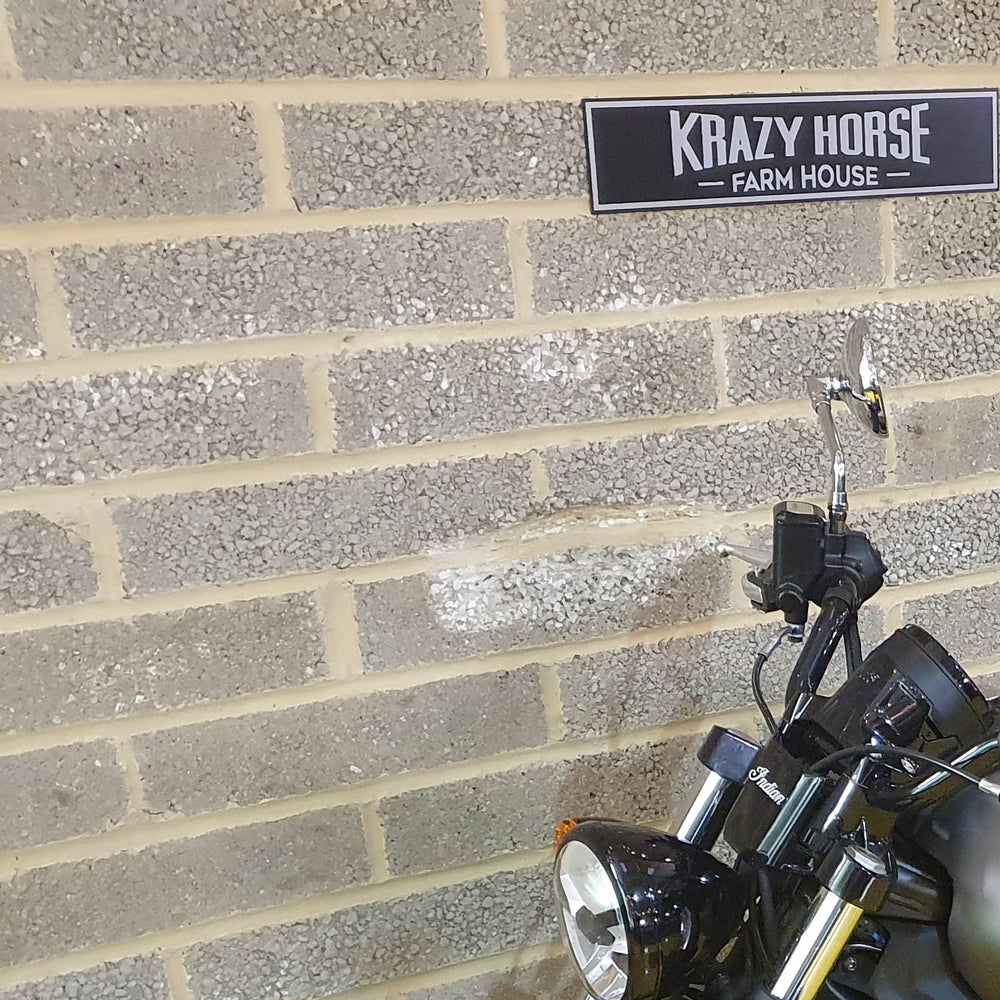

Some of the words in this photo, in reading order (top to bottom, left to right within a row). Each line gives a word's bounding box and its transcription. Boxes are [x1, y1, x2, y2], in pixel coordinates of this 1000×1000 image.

[669, 109, 804, 177] KRAZY
[813, 102, 931, 165] HORSE
[732, 166, 794, 193] FARM
[801, 163, 879, 189] HOUSE
[748, 766, 785, 806] Indian
